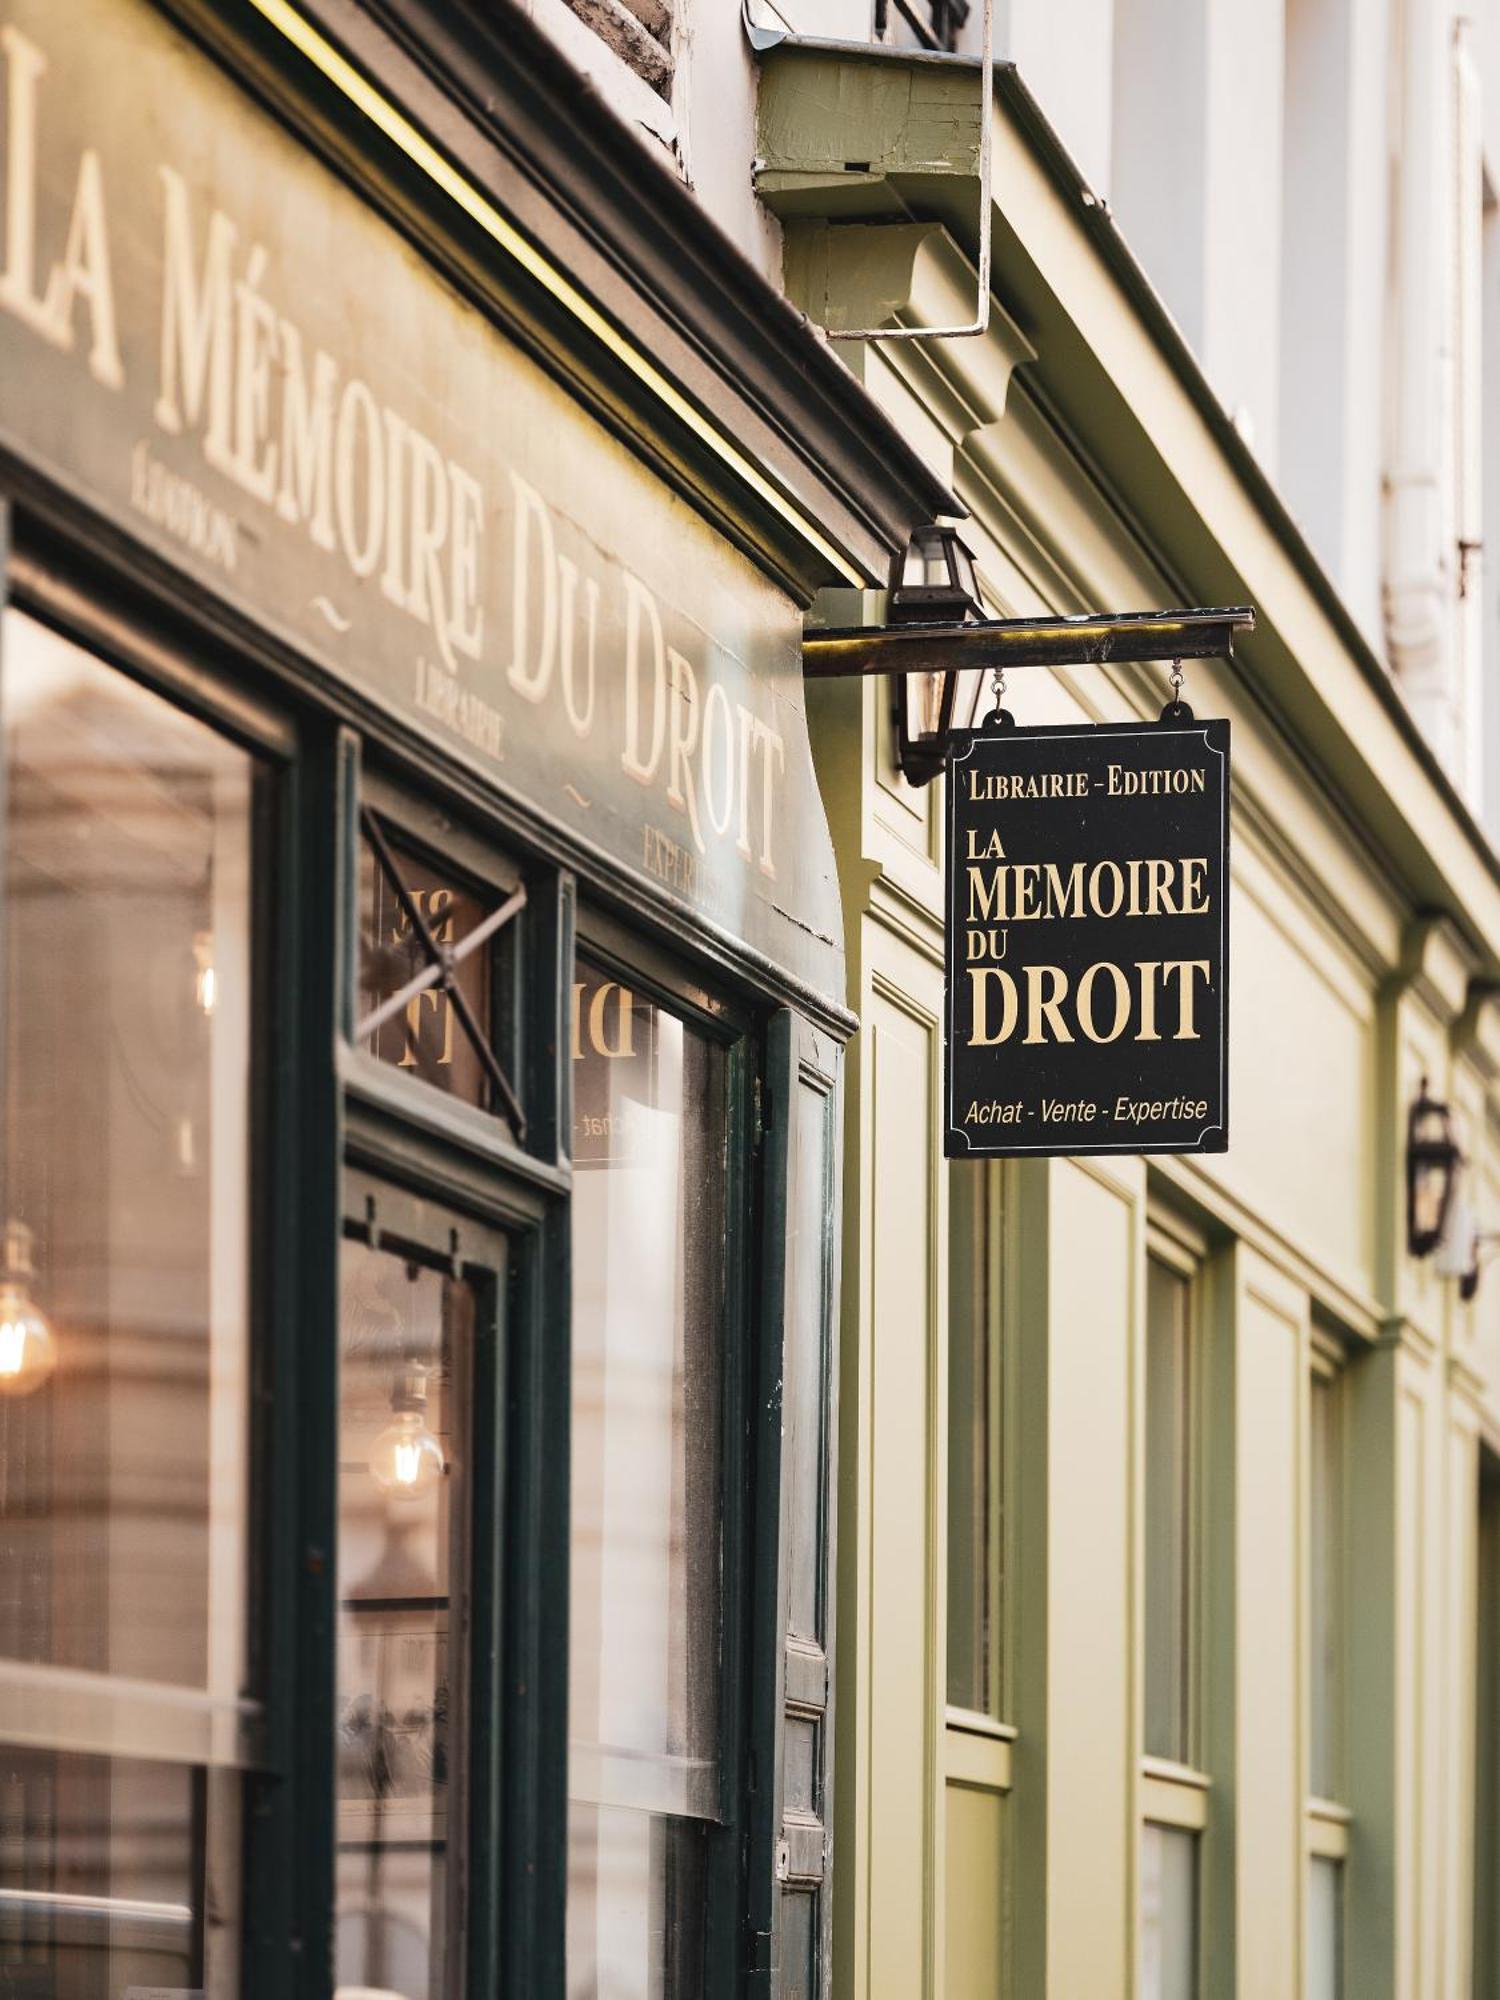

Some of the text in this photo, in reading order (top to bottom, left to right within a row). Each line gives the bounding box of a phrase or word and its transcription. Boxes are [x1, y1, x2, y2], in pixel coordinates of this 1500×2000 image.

[0, 24, 124, 392] LA
[155, 162, 483, 673] MÉMOIRE
[620, 570, 785, 881] DROIT
[968, 769, 1089, 801] LIBRAIRIE
[1107, 764, 1206, 796] EDITION
[966, 828, 1006, 860] LA
[965, 857, 1210, 923] MEMOIRE
[966, 928, 1008, 961] DU
[966, 959, 1211, 1047] DROIT
[964, 1099, 1023, 1124] Achat
[1041, 1098, 1097, 1123] Vente
[1114, 1095, 1208, 1125] Expertise
